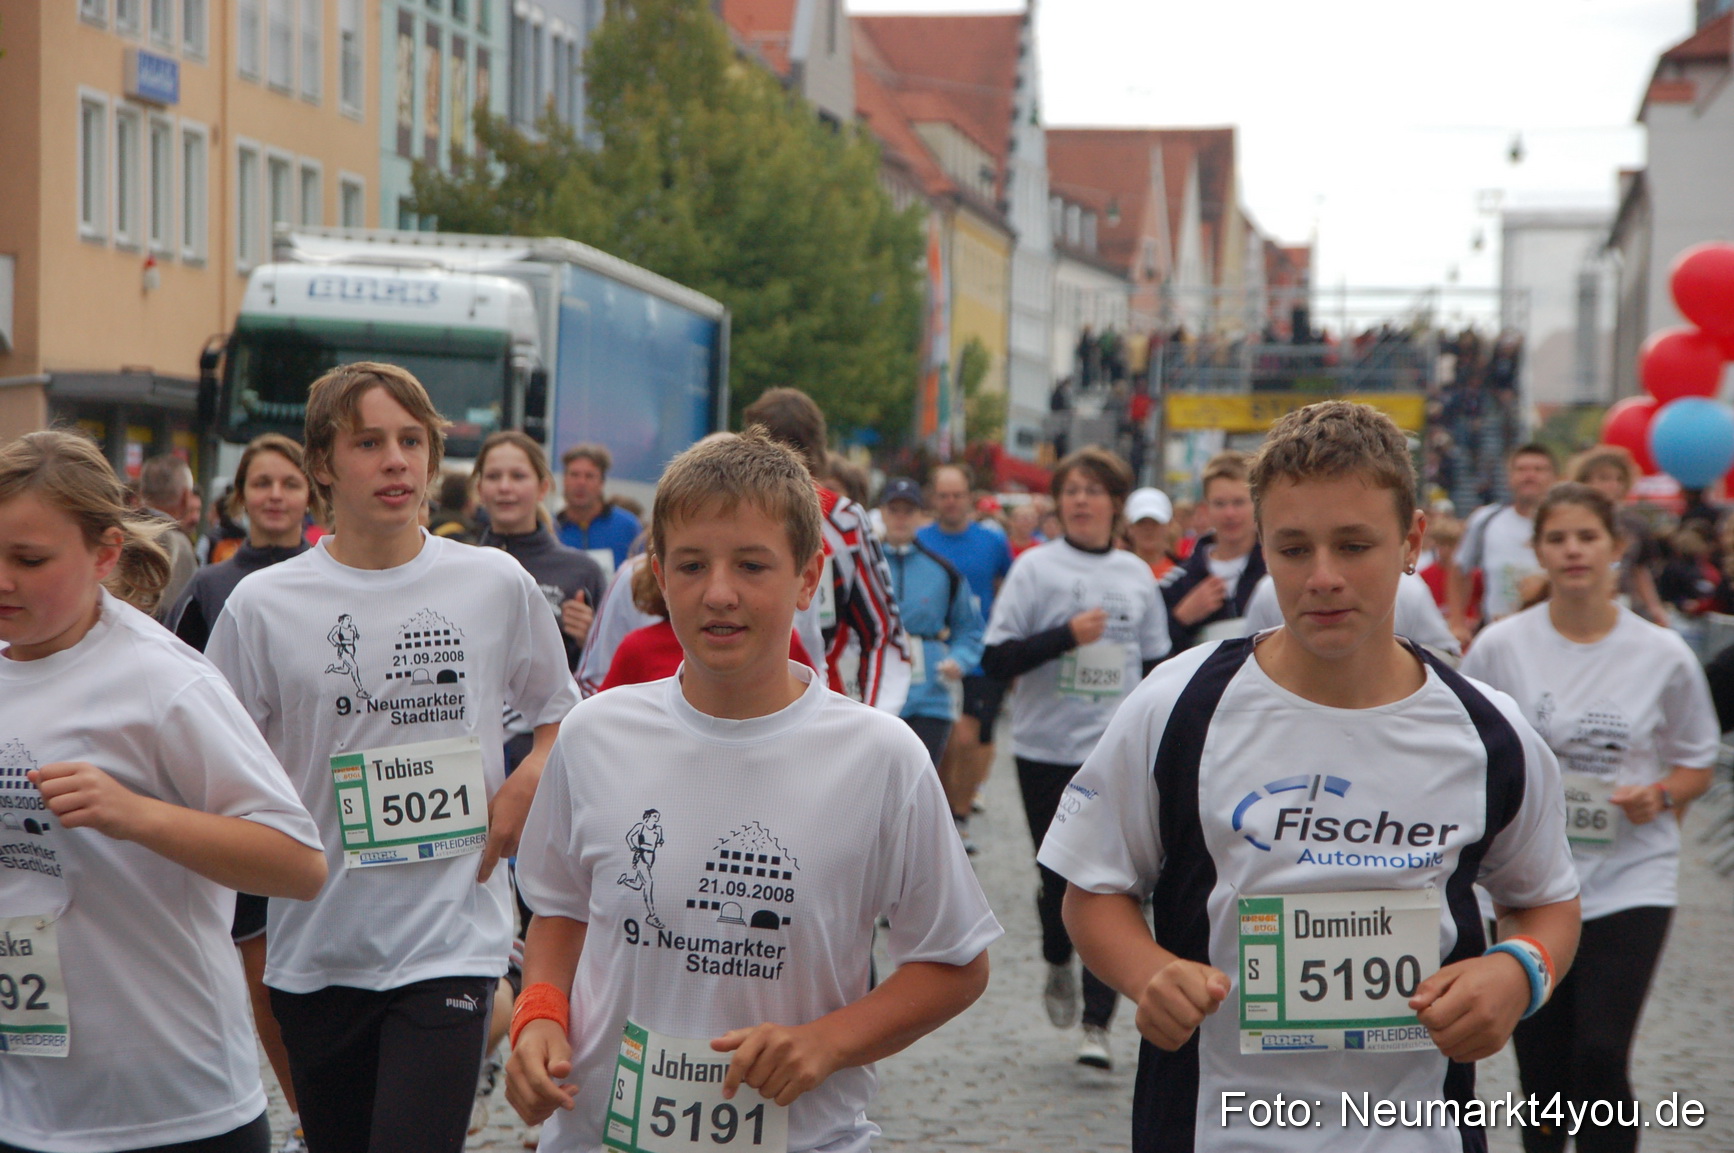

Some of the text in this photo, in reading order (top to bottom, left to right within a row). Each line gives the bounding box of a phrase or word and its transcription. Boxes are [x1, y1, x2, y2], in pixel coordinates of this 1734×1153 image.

[393, 650, 465, 667] 21.09.2008
[335, 692, 465, 716] 9. Neumarkter
[390, 706, 466, 726] Stadtlauf
[372, 757, 434, 781] Tobias
[343, 798, 353, 815] S
[382, 784, 470, 827] 5021
[1273, 807, 1459, 847] Fischer
[434, 833, 487, 851] PFLEIDERER
[698, 877, 795, 903] 21.09.2008
[1294, 906, 1393, 939] Dominik
[0, 931, 33, 956] ska
[623, 918, 786, 960] 9. Neumarkter
[686, 953, 785, 981] Stadtlauf
[1248, 958, 1259, 980] S
[1299, 954, 1422, 1003] 5190
[0, 973, 50, 1010] 92
[446, 997, 474, 1012] PUMA
[9, 1034, 67, 1047] PFLEIDERER
[1367, 1027, 1431, 1043] PFLEIDERE
[615, 1078, 625, 1101] S
[650, 1095, 765, 1145] 5191
